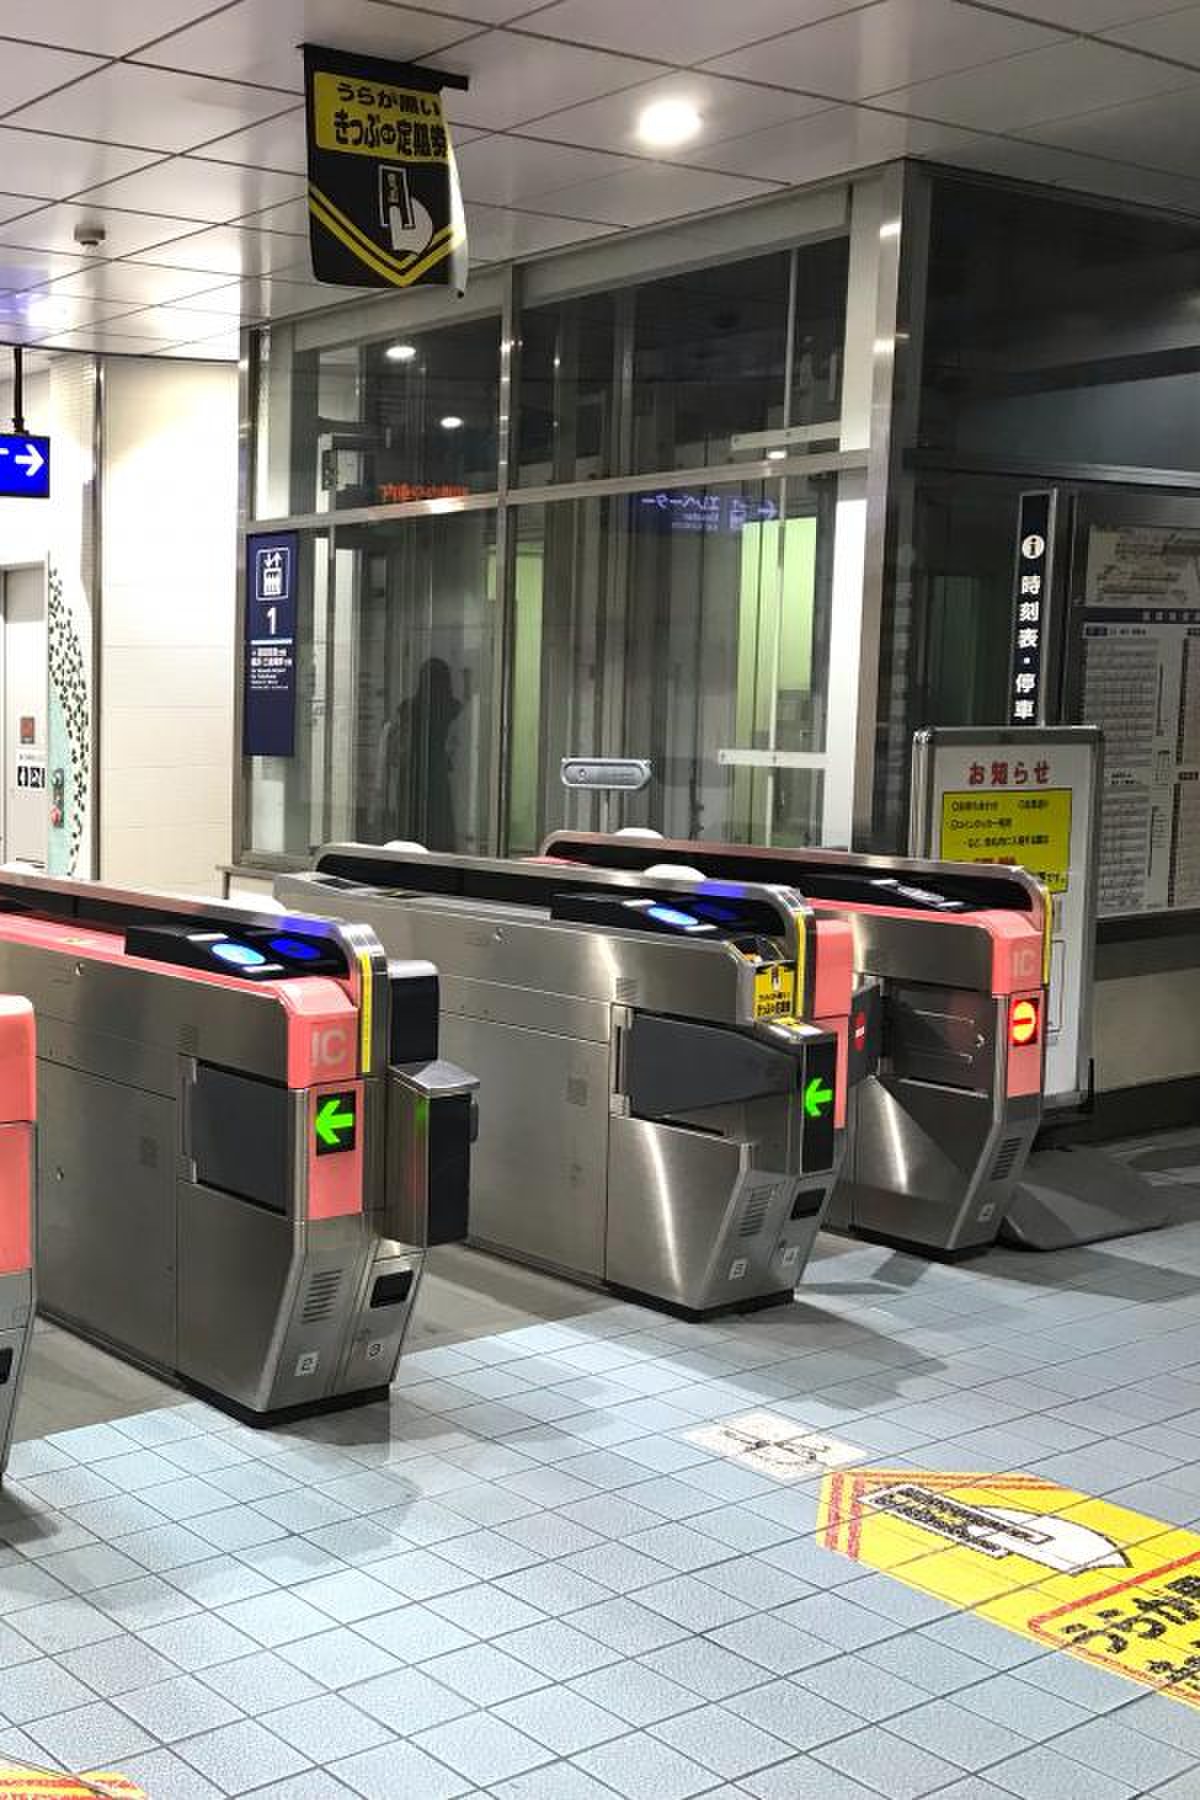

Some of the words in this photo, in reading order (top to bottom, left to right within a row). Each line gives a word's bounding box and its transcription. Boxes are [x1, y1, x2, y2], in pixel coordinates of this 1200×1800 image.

[266, 606, 277, 636] 1
[968, 760, 1050, 786] お知らせ
[1013, 950, 1036, 976] IC
[311, 1027, 347, 1067] IC
